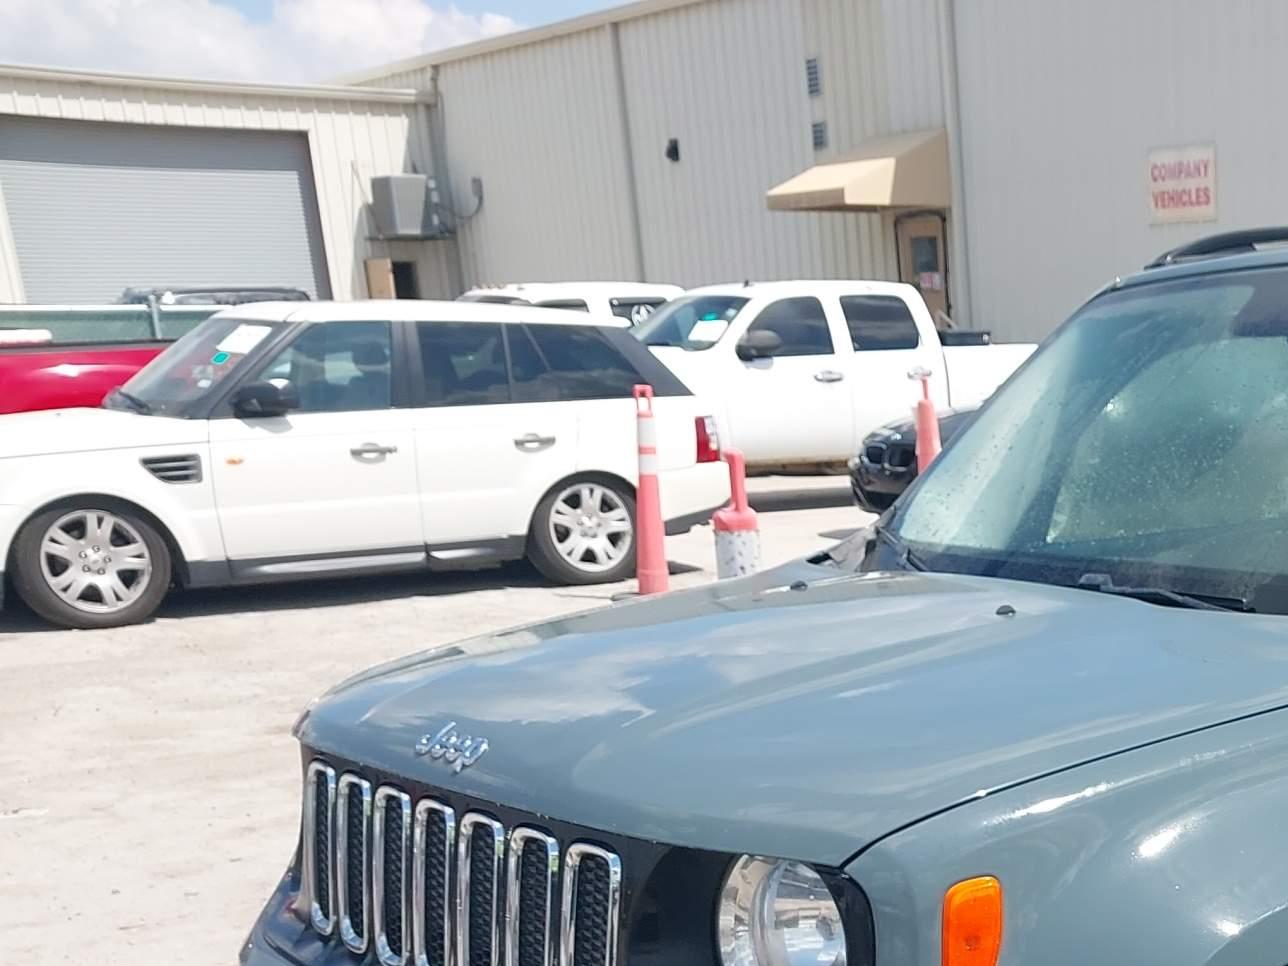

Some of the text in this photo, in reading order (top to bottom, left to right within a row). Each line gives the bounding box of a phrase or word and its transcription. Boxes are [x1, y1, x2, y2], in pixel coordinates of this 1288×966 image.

[1151, 160, 1208, 182] COMPANY
[1152, 187, 1210, 208] VEHICLES
[416, 721, 489, 774] Jeep
